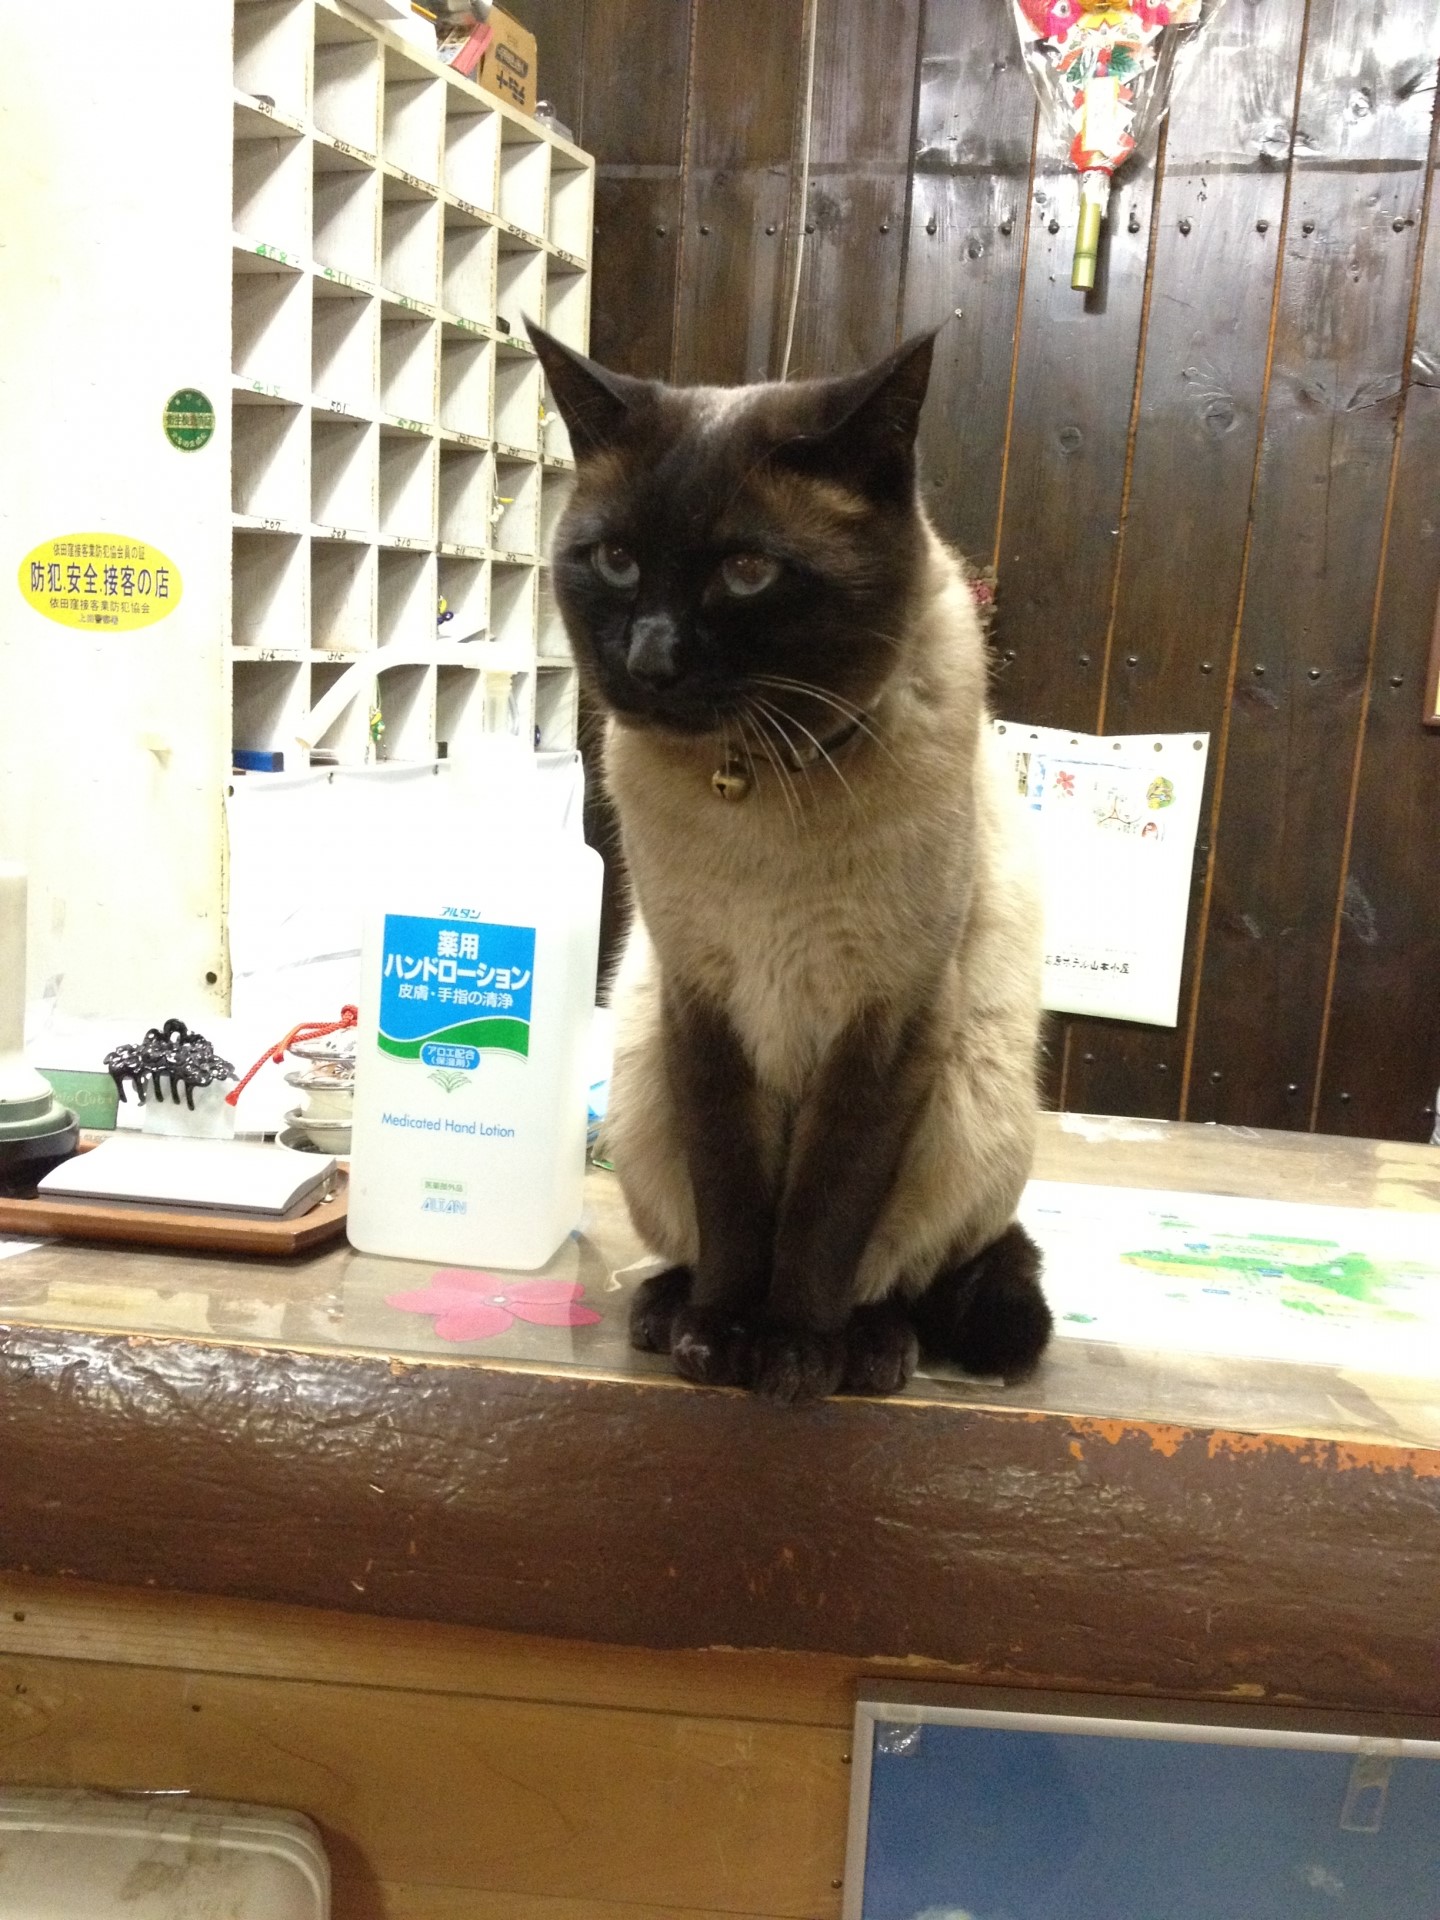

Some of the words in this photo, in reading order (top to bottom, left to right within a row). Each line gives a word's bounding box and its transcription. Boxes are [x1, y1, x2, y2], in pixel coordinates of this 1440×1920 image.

[258, 102, 273, 117] 401
[333, 139, 350, 153] 402
[261, 518, 281, 531] 507
[330, 527, 347, 539] 508
[395, 537, 411, 547] 510
[50, 597, 150, 614] 依田窪接客業防犯協会
[439, 906, 481, 919] アルタン
[437, 930, 480, 960] 薬用
[384, 953, 532, 991] ハンドローション
[398, 984, 513, 1009] 皮膚・手指の清浄
[427, 1045, 476, 1060] アロエ配合
[381, 1112, 441, 1131] Medicated
[444, 1119, 476, 1134] Hand
[479, 1122, 515, 1138] Lotion
